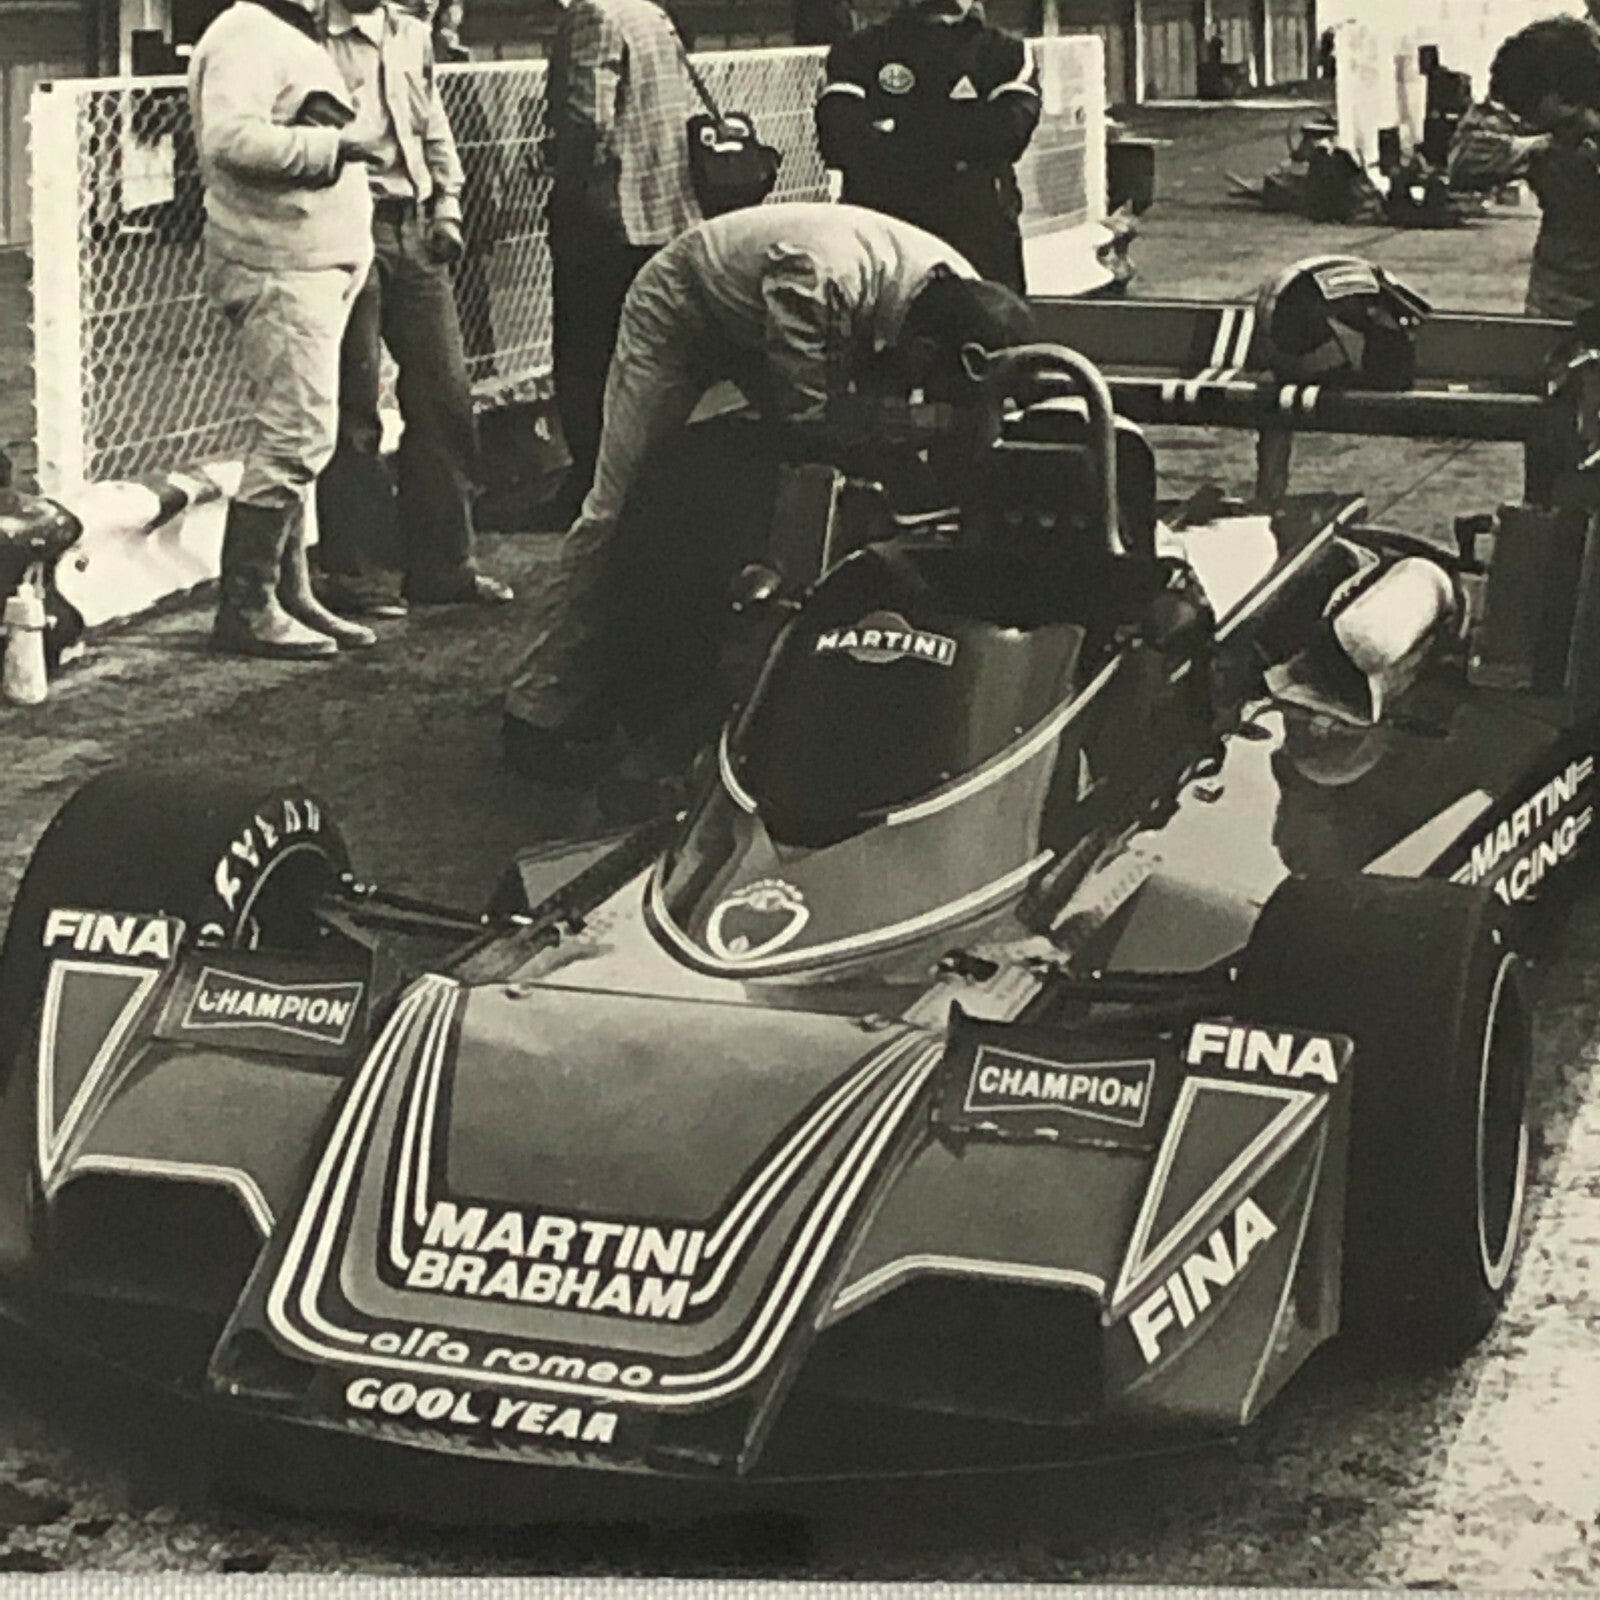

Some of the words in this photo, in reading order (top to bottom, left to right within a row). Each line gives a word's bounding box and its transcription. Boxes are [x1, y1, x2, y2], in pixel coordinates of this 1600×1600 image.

[815, 629, 949, 660] MARTINI
[43, 909, 171, 959] FINA
[199, 988, 353, 1027] CHAMPION
[1187, 1022, 1338, 1084] FINA
[978, 1065, 1144, 1108] CHAMPION
[423, 1201, 706, 1277] MARTINI
[406, 1248, 691, 1320] BRABHAM
[1128, 1197, 1278, 1364] FINA
[370, 1328, 470, 1364] alfa
[483, 1347, 654, 1388] romeo
